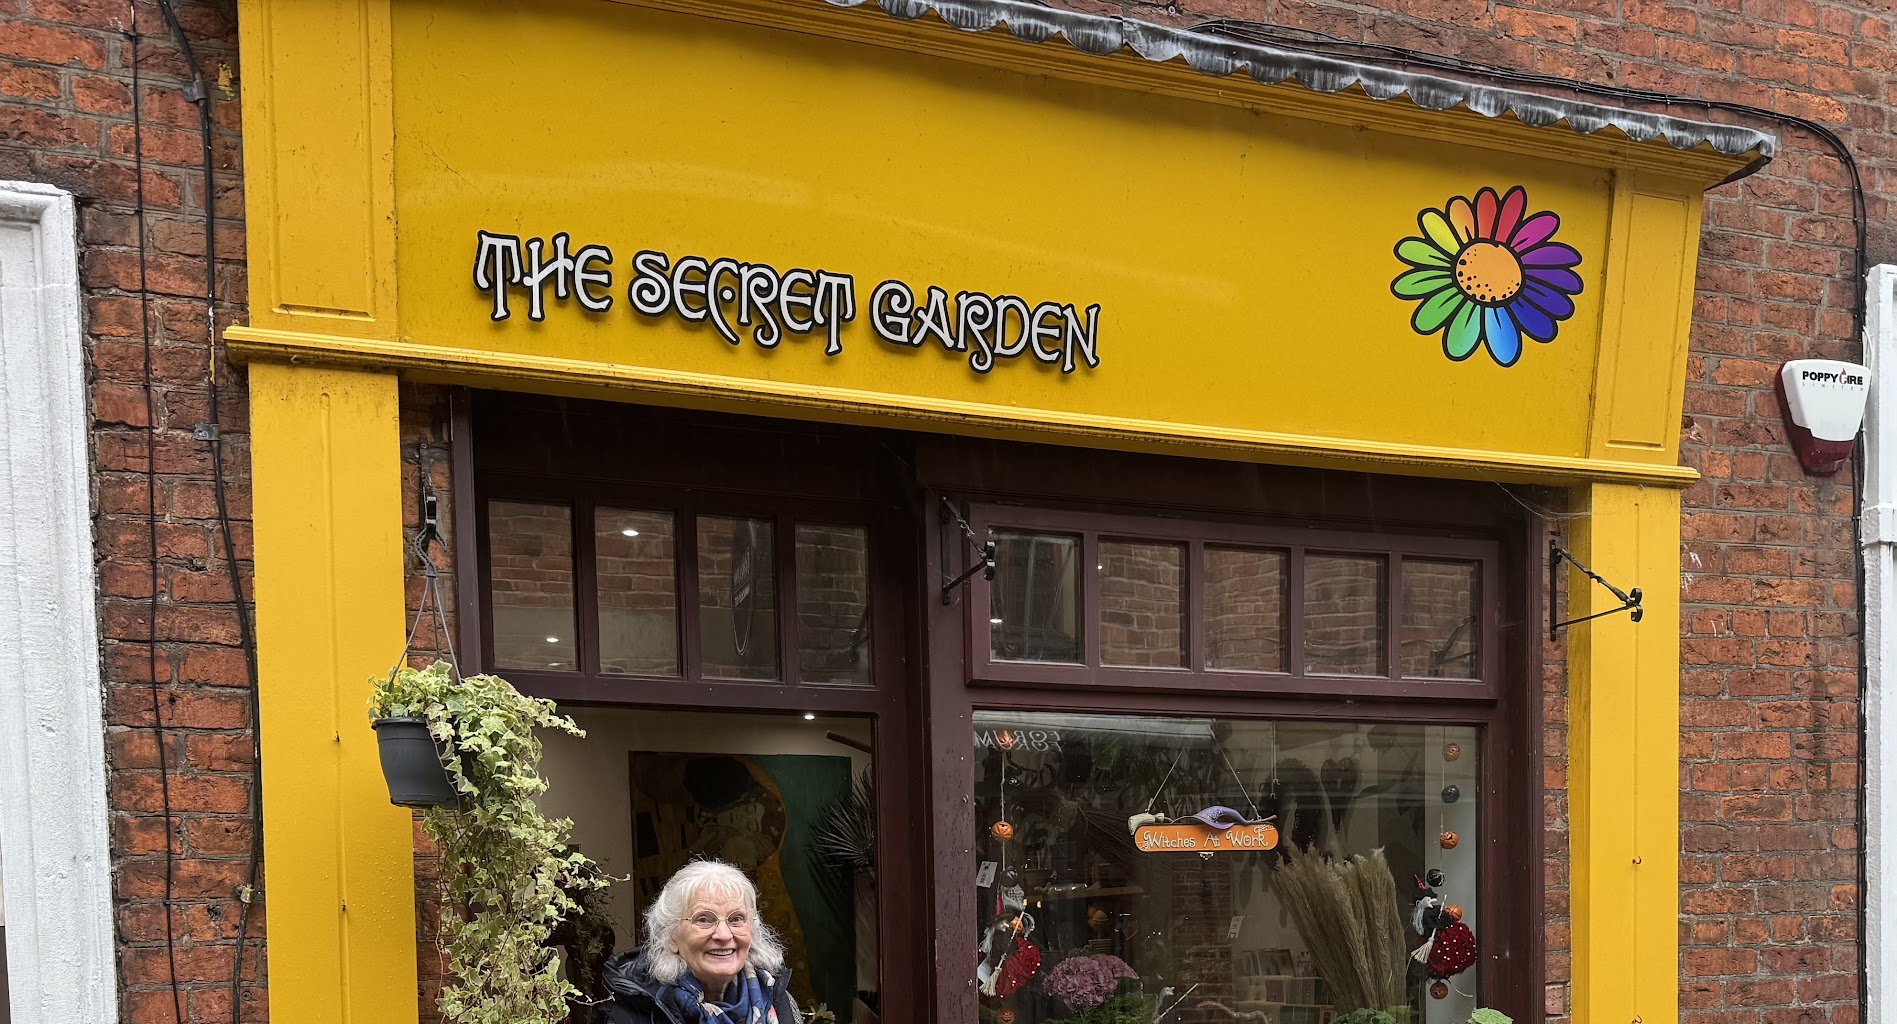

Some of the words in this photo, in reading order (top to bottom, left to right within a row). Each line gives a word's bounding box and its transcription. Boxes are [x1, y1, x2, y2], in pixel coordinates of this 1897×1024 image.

[473, 230, 613, 322] THE
[628, 250, 854, 356] SECRET
[869, 279, 1100, 375] GARDEN
[1802, 383, 1864, 392] LIMITED
[1144, 831, 1196, 848] Witches
[1203, 832, 1220, 848] At
[1225, 827, 1268, 847] Work
